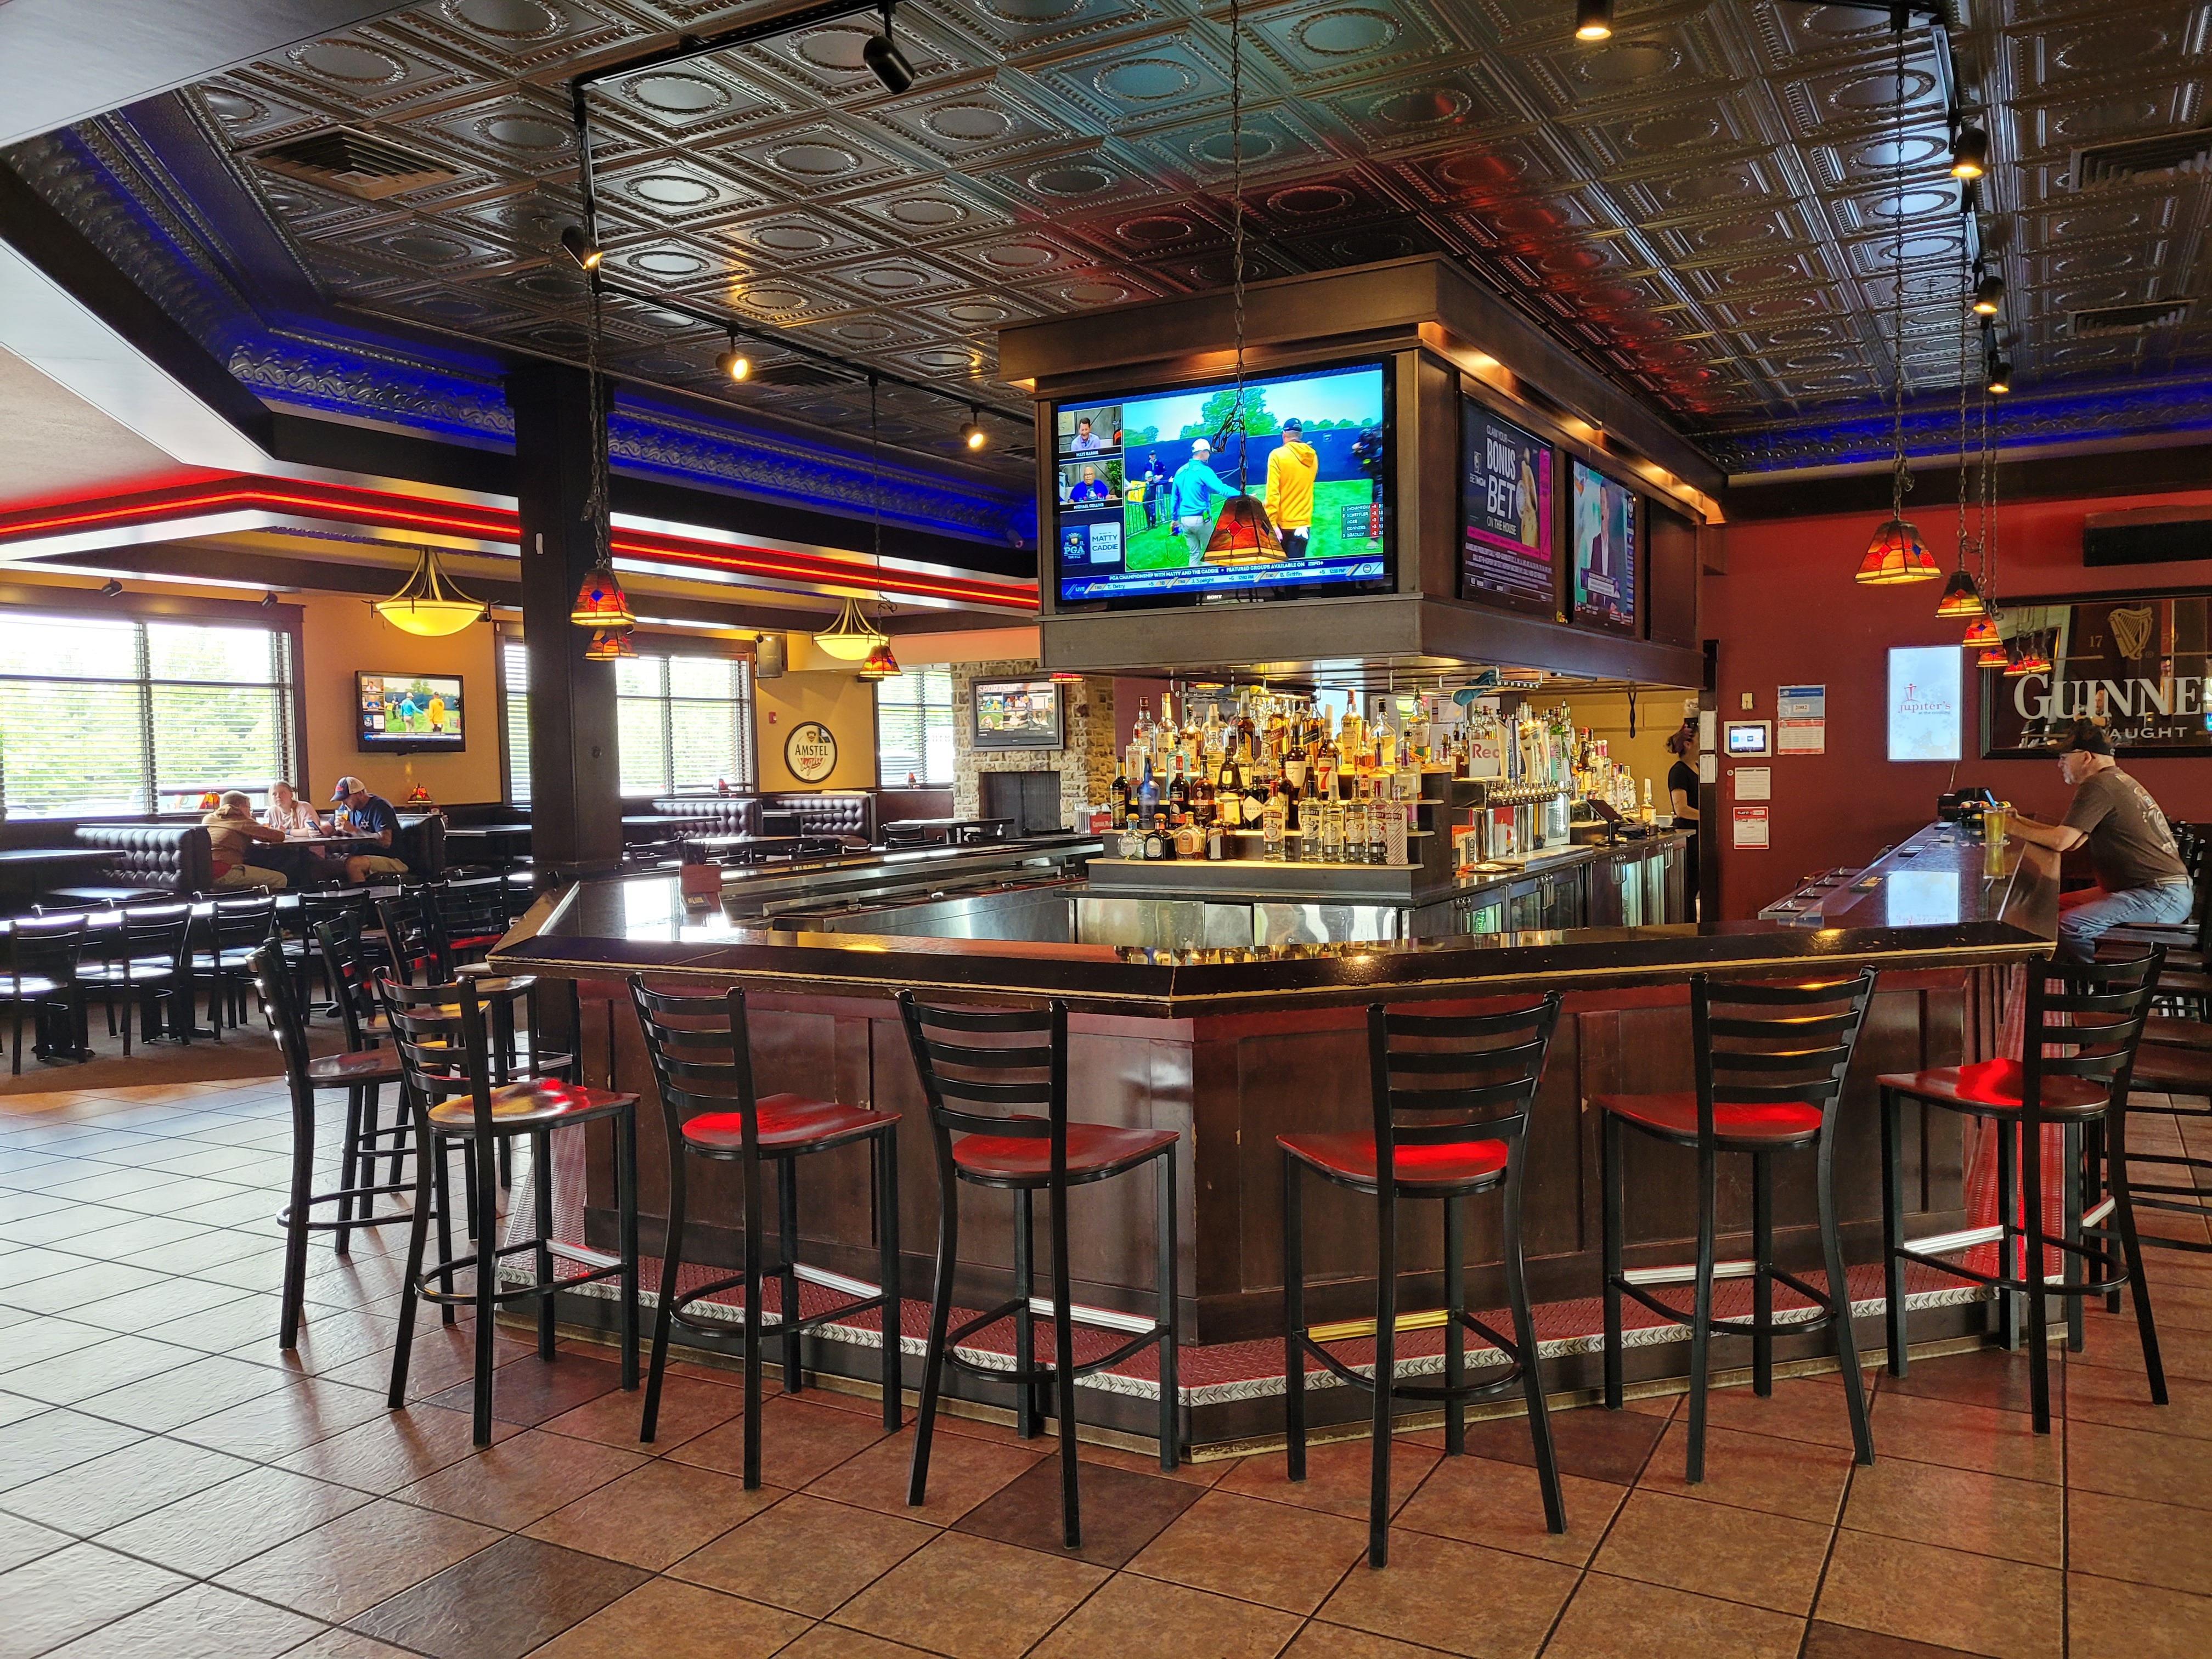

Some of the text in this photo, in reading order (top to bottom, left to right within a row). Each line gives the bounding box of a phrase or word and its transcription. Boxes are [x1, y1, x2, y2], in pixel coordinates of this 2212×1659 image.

[1486, 437, 1516, 481] BONUS
[1487, 474, 1516, 520] BET
[1487, 516, 1517, 535] ON THE HOUSE
[1063, 545, 1085, 554] PGA
[2089, 635, 2103, 648] 17
[1898, 701, 1951, 713] jupiter's
[2103, 726, 2188, 739] AUGHT
[795, 744, 828, 756] AMSTEL
[1319, 766, 1333, 789] 7
